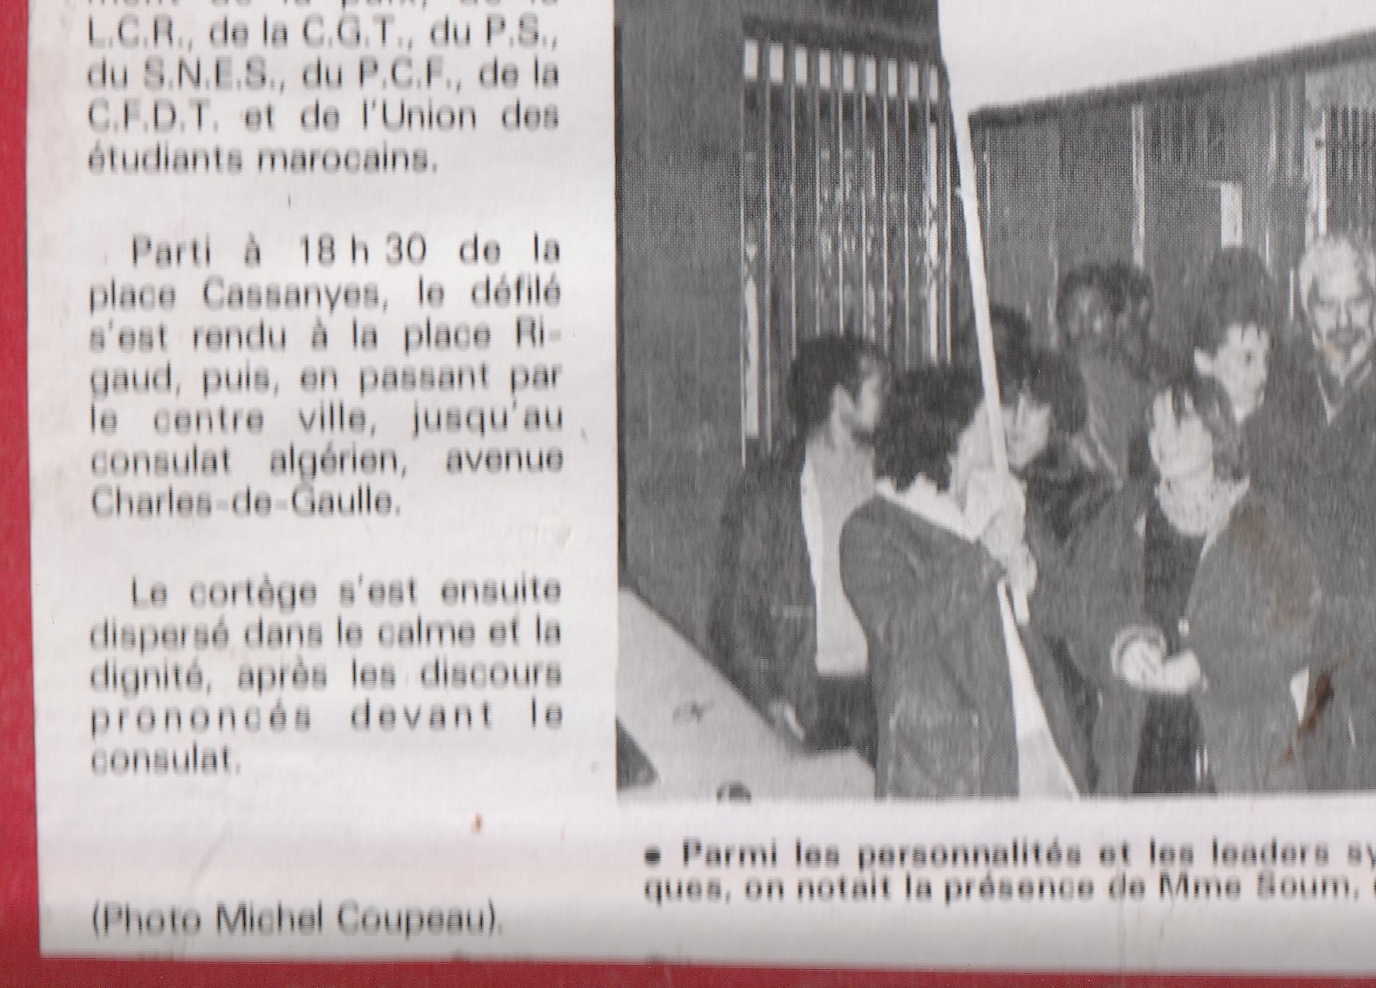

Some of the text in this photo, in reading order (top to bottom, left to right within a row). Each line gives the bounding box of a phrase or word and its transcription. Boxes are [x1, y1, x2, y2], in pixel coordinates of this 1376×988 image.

[208, 14, 250, 48] de
[429, 14, 472, 48] du
[86, 56, 129, 90] du
[301, 56, 344, 90] du
[477, 56, 520, 89] de
[532, 56, 560, 89] la
[243, 102, 275, 132] et
[299, 98, 341, 132] de
[500, 98, 560, 131] des
[86, 142, 438, 174] étudiants marocains.
[131, 232, 562, 268] Parti 18 h 30 de la
[88, 274, 562, 314] place Cassanyes, le défilé
[192, 318, 288, 352] rendu
[351, 317, 379, 351] la
[403, 317, 492, 353] place
[89, 360, 562, 398] gaud, puis, passant par
[152, 405, 265, 435] centre
[297, 401, 376, 438] ville,
[90, 441, 565, 480] consulat algérien, avenue
[90, 482, 401, 519] Charles-de-Gaulle.
[130, 575, 169, 609] Le
[188, 574, 318, 613] cortège
[439, 574, 562, 606] ensuite
[88, 615, 562, 656] dispersé dans calme et la
[89, 657, 563, 698] dignité, après les discours
[90, 700, 492, 738] prononcés devant
[90, 742, 240, 775] consulat.
[681, 837, 779, 869] Parmi
[794, 837, 841, 869] les
[857, 836, 1082, 870] personnalités
[1097, 839, 1132, 868] et
[1148, 836, 1195, 870] les
[1211, 836, 1330, 870] leaders
[643, 878, 731, 906] ques,
[744, 878, 785, 901] on
[796, 869, 891, 902] notait
[904, 870, 933, 902] la
[943, 869, 1095, 906] présence
[1107, 870, 1147, 902] de
[1158, 869, 1242, 900] Mme
[1256, 869, 1359, 900] Soum,
[91, 900, 202, 937] (Photo
[215, 900, 324, 935] Michel
